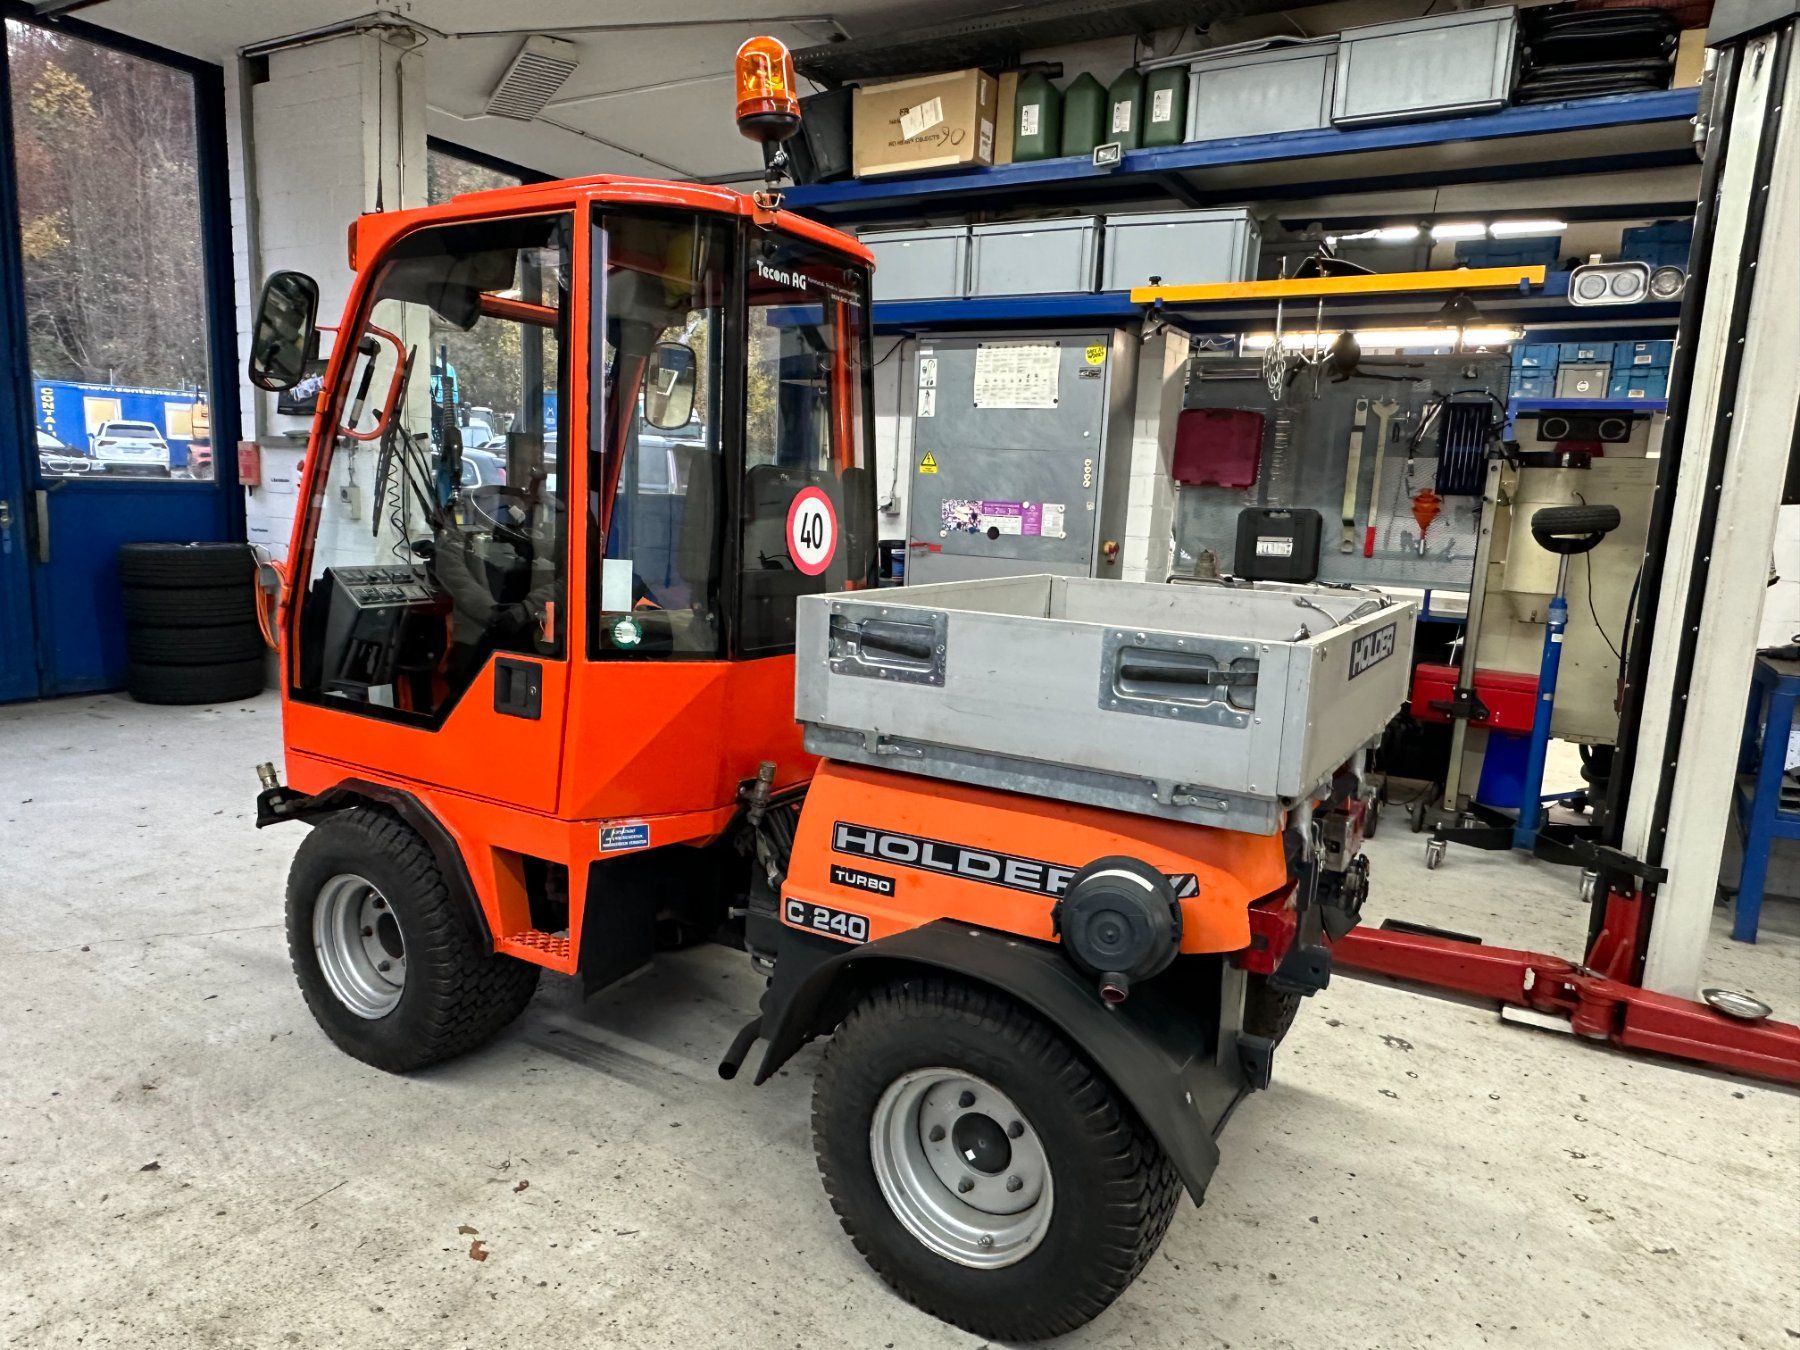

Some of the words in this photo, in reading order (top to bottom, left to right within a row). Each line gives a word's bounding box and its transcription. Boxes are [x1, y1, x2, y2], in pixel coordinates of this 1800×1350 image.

[937, 126, 966, 148] 90
[756, 259, 790, 286] Tecom
[792, 272, 807, 290] AG
[800, 512, 823, 550] 40
[1351, 624, 1395, 677] HOLDER
[835, 870, 891, 892] TURBO
[787, 900, 804, 923] C
[812, 907, 866, 940] 240
